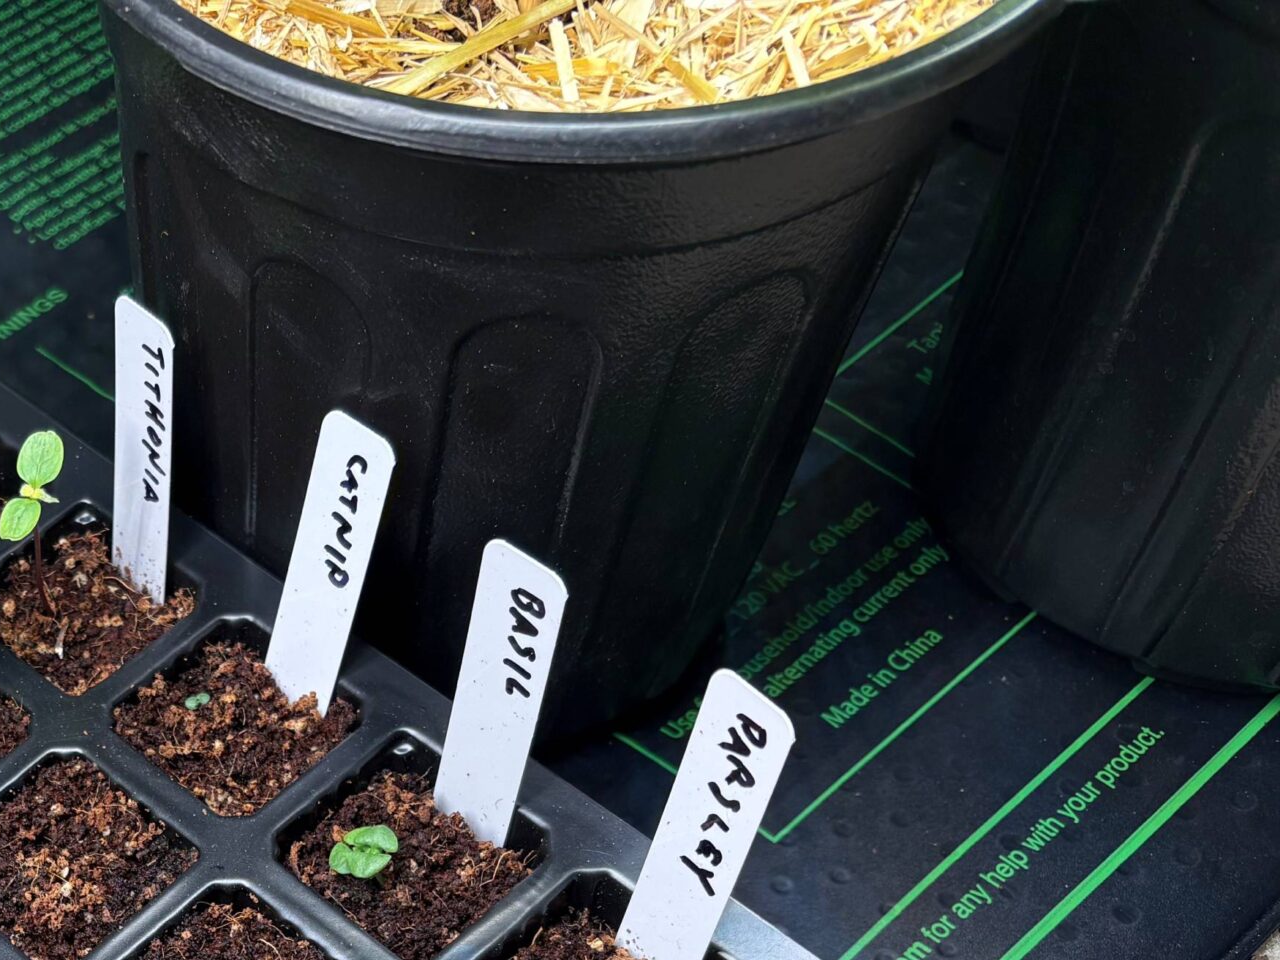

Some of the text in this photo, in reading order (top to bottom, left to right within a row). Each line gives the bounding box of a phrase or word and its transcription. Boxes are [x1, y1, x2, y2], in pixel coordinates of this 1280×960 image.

[141, 343, 166, 502] TITHONIA
[324, 454, 368, 589] CATNIP
[827, 500, 880, 538] hertz
[502, 588, 546, 698] BASIL
[737, 567, 868, 681] ousehold/indoor
[865, 546, 899, 573] use
[894, 516, 932, 549] only
[763, 543, 950, 698] alternating current only
[820, 629, 944, 729] Made in China
[680, 713, 767, 896] PARSLEY
[921, 915, 956, 944] for
[951, 884, 992, 920] any
[979, 849, 1029, 889] help
[1021, 816, 1065, 853] with
[1057, 781, 1101, 824] your
[1094, 725, 1165, 789] product.
